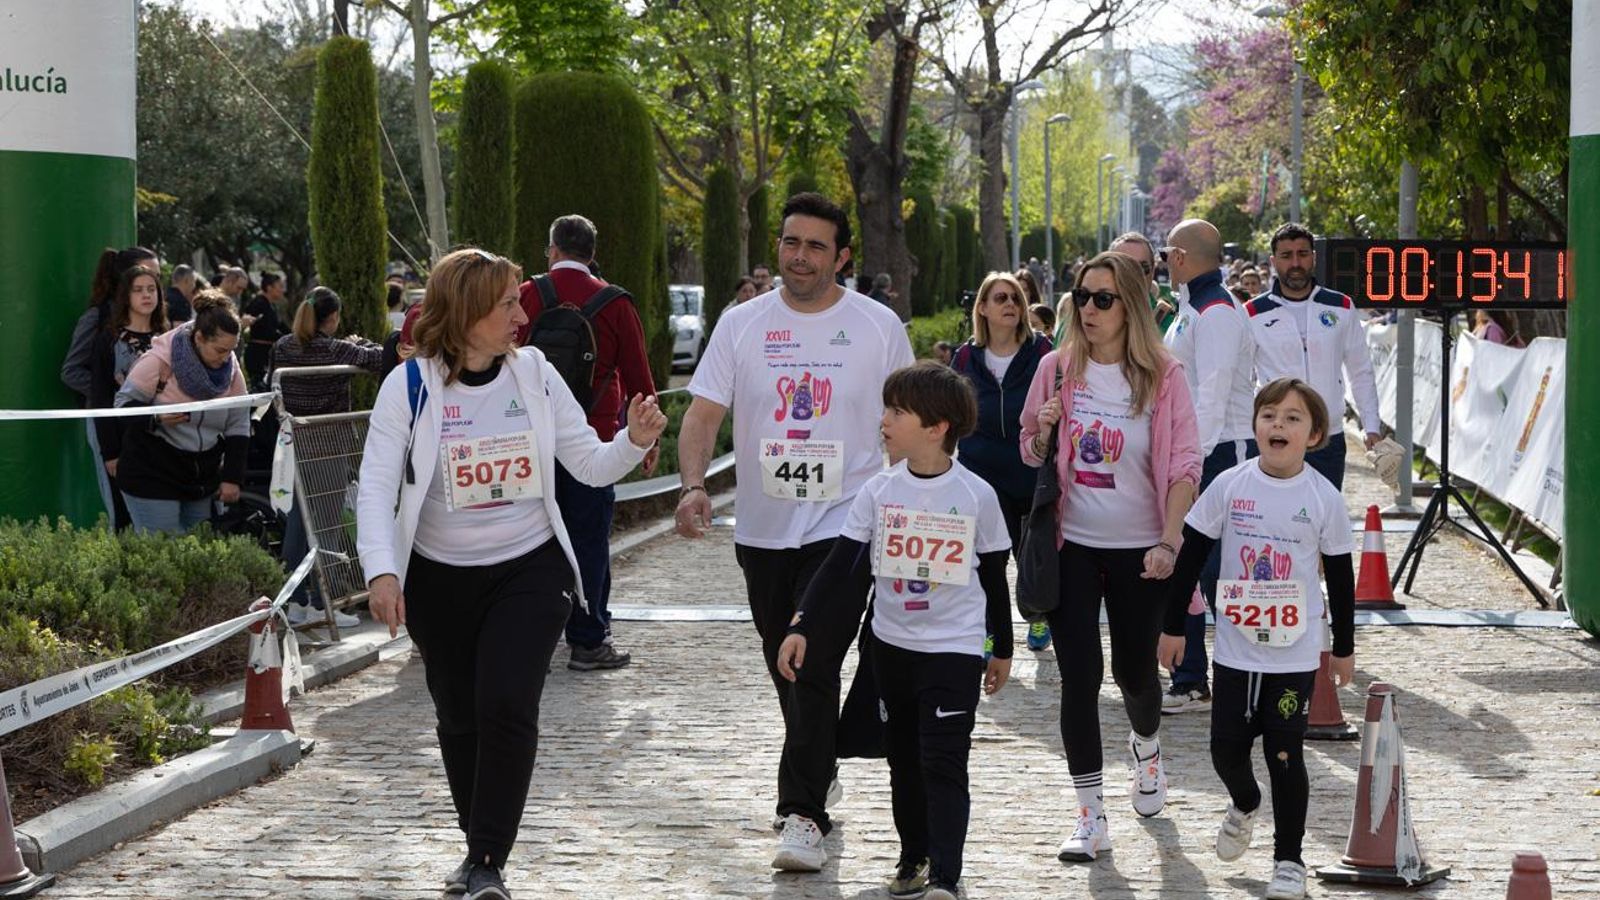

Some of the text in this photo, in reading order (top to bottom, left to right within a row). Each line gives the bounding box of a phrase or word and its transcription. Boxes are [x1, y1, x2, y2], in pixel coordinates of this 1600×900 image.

[0, 67, 67, 94] lucía
[766, 330, 791, 342] XXVII
[456, 456, 532, 488] 5073
[775, 462, 824, 483] 441
[886, 534, 964, 564] 5072
[1225, 604, 1299, 627] 5218
